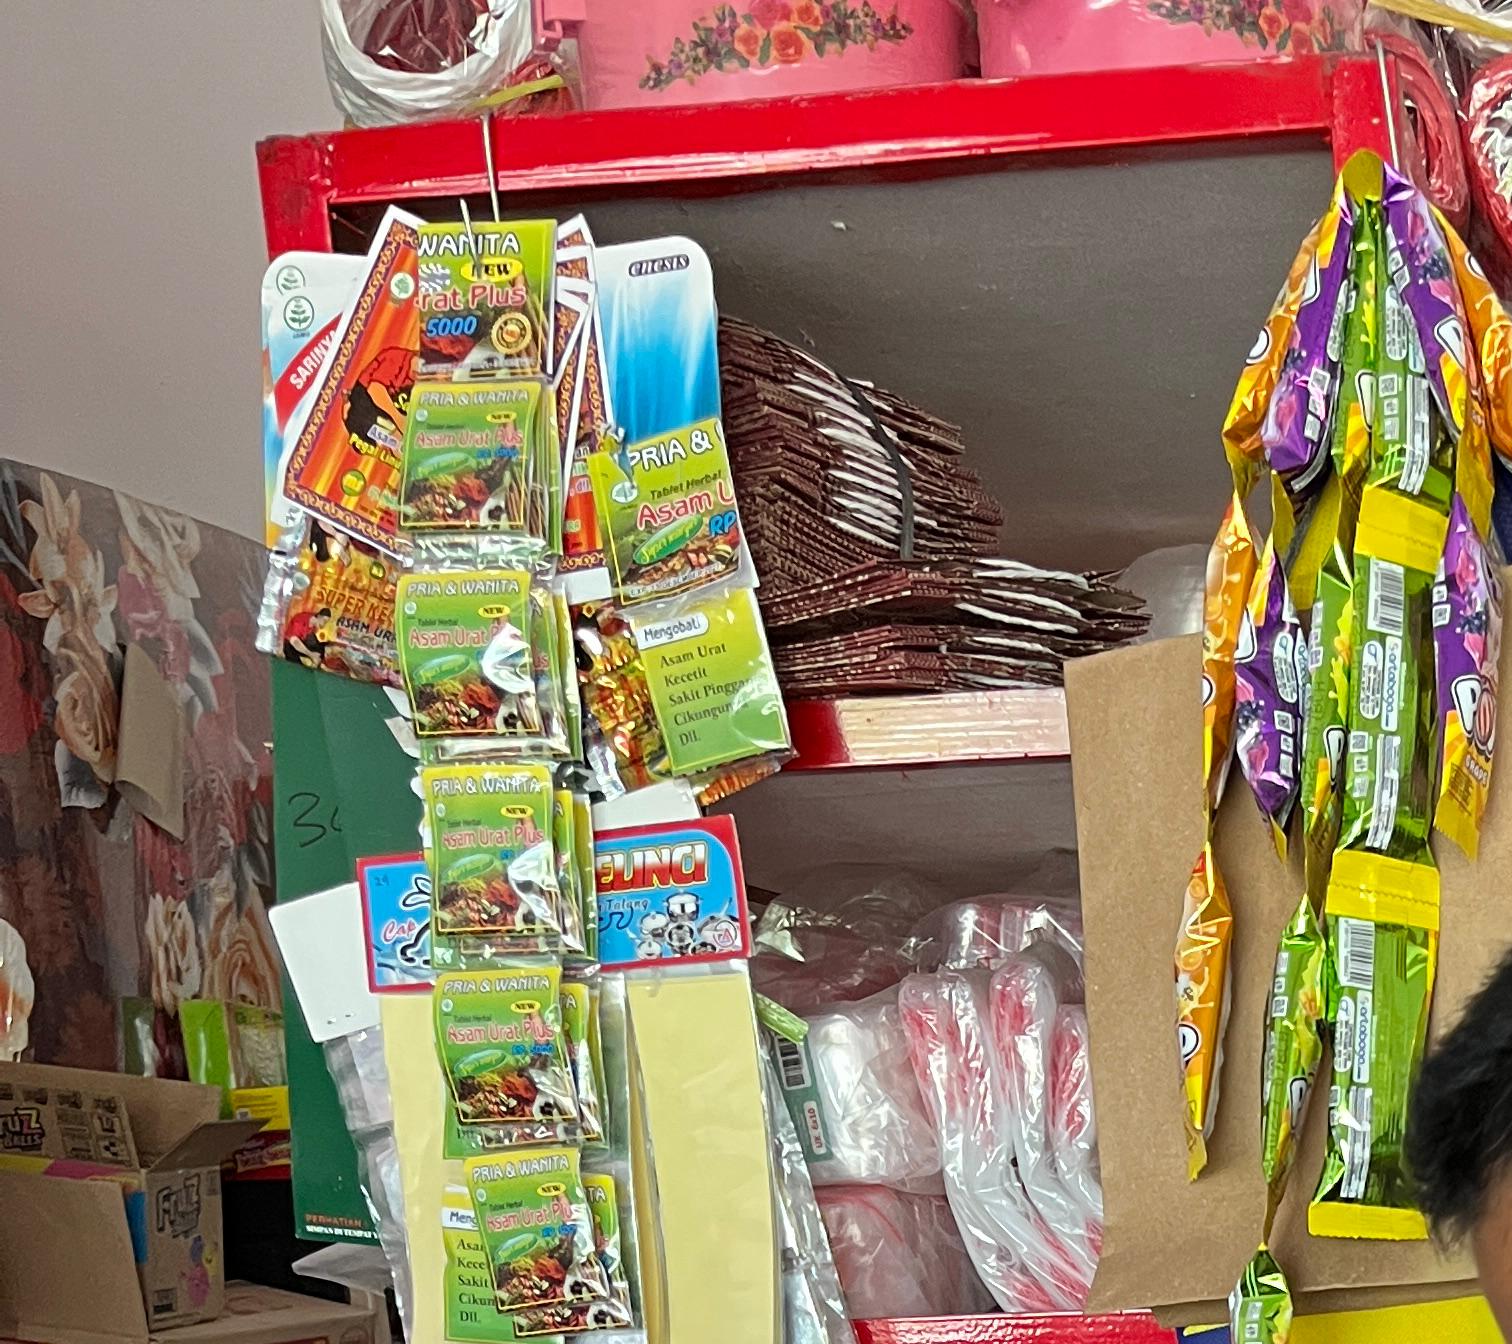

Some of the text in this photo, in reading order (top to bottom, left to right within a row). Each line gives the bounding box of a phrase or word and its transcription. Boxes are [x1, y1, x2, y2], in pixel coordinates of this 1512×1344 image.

[416, 283, 527, 311] rat Plus
[425, 315, 478, 337] 5000
[419, 391, 456, 406] PRIA
[472, 389, 530, 405] WANITA
[415, 430, 524, 448] Asam Urat Plus
[629, 430, 713, 471] PRIA &
[650, 470, 722, 500] Tablet Herbal
[637, 491, 713, 531] Asam
[408, 583, 443, 597] PRIA
[462, 579, 521, 594] WANITA
[482, 605, 506, 616] NEW
[409, 627, 487, 648] Asam Urat
[659, 643, 727, 669] Asam Urat
[664, 667, 708, 688] Kecetit
[668, 689, 701, 708] Sakit
[433, 778, 463, 796] PRIA
[505, 805, 529, 818] NEW
[442, 825, 544, 847] Asam Urat Plus
[598, 842, 709, 896] ELINCI
[444, 979, 476, 994] PRIA
[495, 976, 551, 992] WANITA
[515, 1002, 536, 1013] NEW
[447, 1021, 554, 1043] Asam Urat Plus
[472, 1165, 502, 1183] PRIA
[519, 1155, 570, 1176] WANITA
[540, 1184, 562, 1195] NEW
[521, 1208, 549, 1229] Urat
